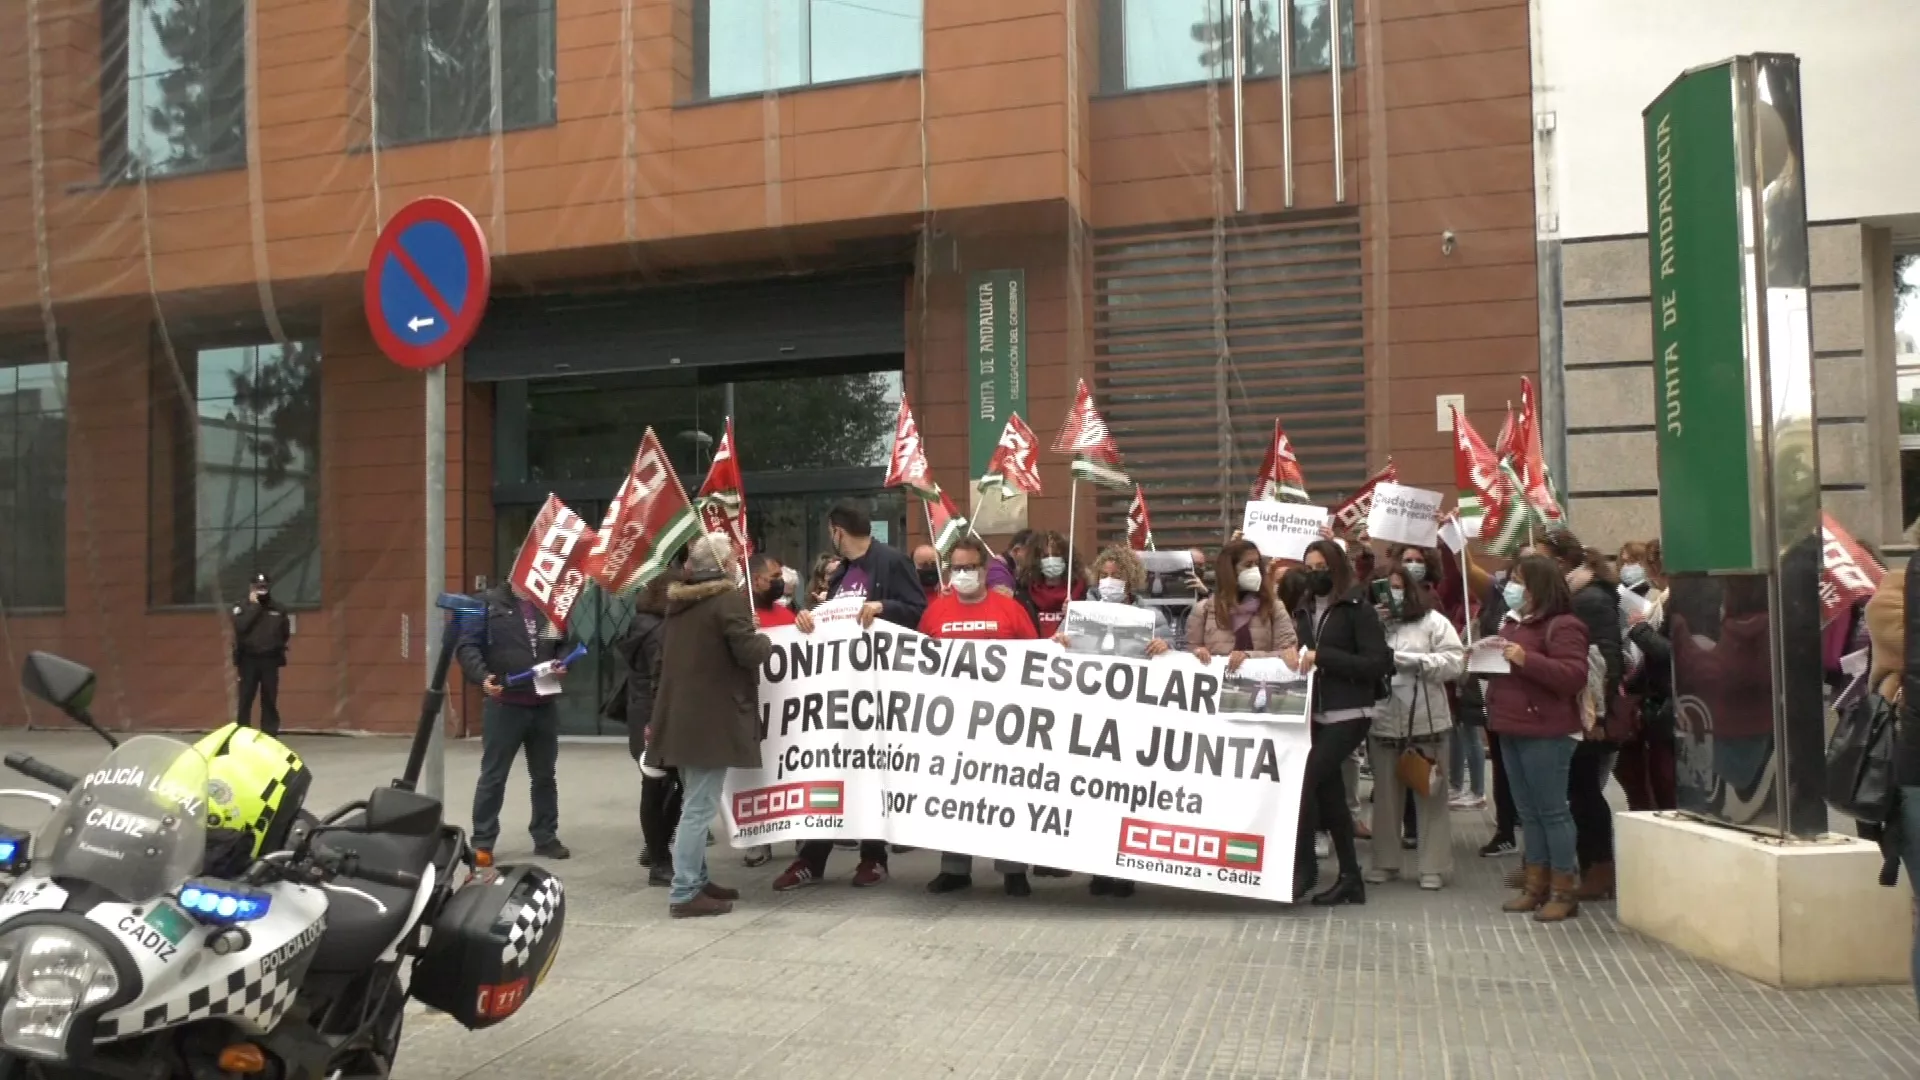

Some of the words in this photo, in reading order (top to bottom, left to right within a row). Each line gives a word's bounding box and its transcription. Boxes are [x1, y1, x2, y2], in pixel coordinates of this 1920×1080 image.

[1656, 112, 1675, 281] ANDALUCIA
[1661, 289, 1677, 332] DE
[1009, 327, 1018, 344] DEL
[980, 358, 995, 376] DE
[980, 380, 995, 422] JUNTA
[1664, 341, 1682, 438] JUNTA
[1249, 510, 1322, 528] Ciudadanos
[1266, 523, 1278, 532] en
[1386, 506, 1398, 516] en
[813, 606, 859, 617] iudadanos
[941, 620, 987, 633] CCOO
[1037, 611, 1065, 623] COO
[763, 630, 1008, 684] ONITORES/AS
[780, 689, 955, 737] PRECARIO
[967, 700, 1055, 751] POR
[1068, 712, 1122, 762] LA
[1136, 725, 1280, 783] JUNTA
[777, 741, 921, 780] ¡Contrataión
[928, 754, 946, 776] a
[950, 750, 1060, 793] jornada
[1070, 774, 1203, 815] completa
[737, 788, 805, 818] CCOO
[924, 795, 1016, 828] centro
[1027, 802, 1073, 838] YA!
[804, 815, 844, 829] Cádiz
[1125, 824, 1220, 860] CCOO
[1115, 852, 1202, 878] Enseñanza
[1217, 867, 1262, 886] Cádiz
[117, 915, 178, 964] CADIZ
